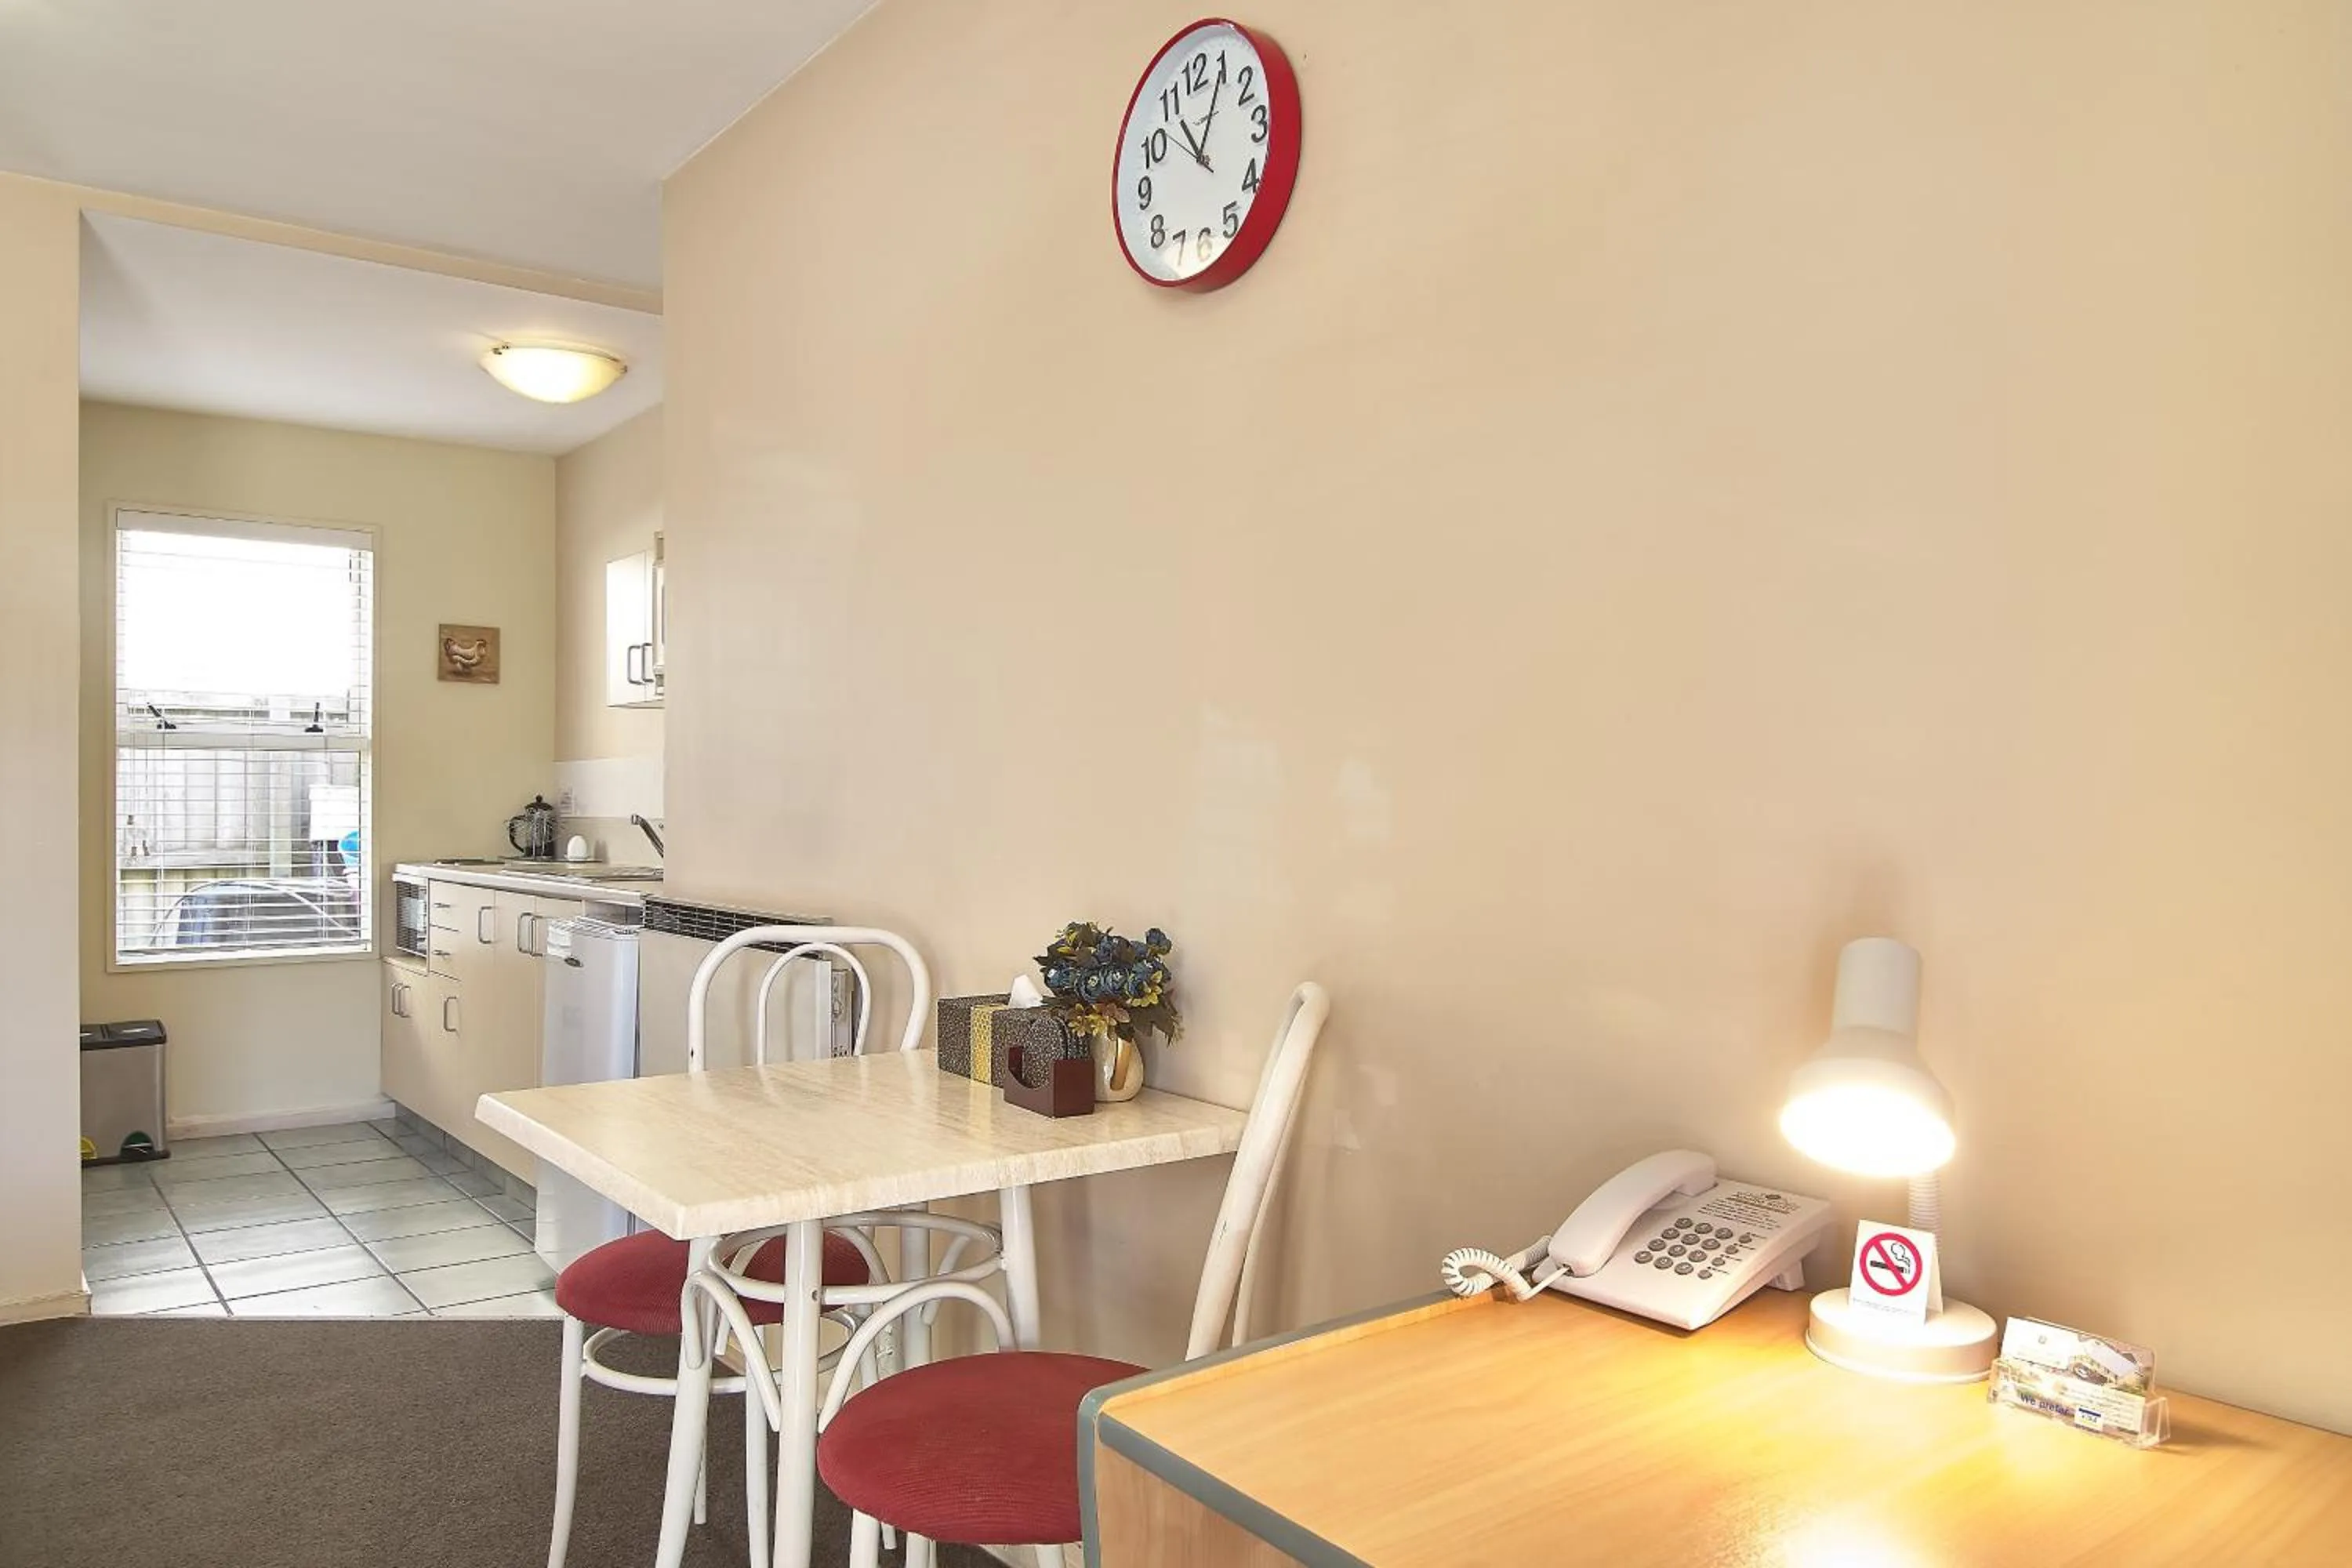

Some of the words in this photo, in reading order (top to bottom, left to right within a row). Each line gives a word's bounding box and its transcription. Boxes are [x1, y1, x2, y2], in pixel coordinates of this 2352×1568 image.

[1182, 53, 1209, 96] 12
[1217, 50, 1227, 84] 1
[1160, 82, 1180, 122] 11
[1238, 66, 1254, 107] 2
[1251, 104, 1268, 143] 3
[1142, 128, 1167, 169] 10
[1138, 176, 1152, 210] 9
[1242, 158, 1260, 193] 4
[1151, 214, 1166, 249] 8
[1223, 201, 1240, 238] 5
[1172, 229, 1186, 266] 7
[1196, 227, 1212, 262] 6
[2020, 1392, 2036, 1406] We
